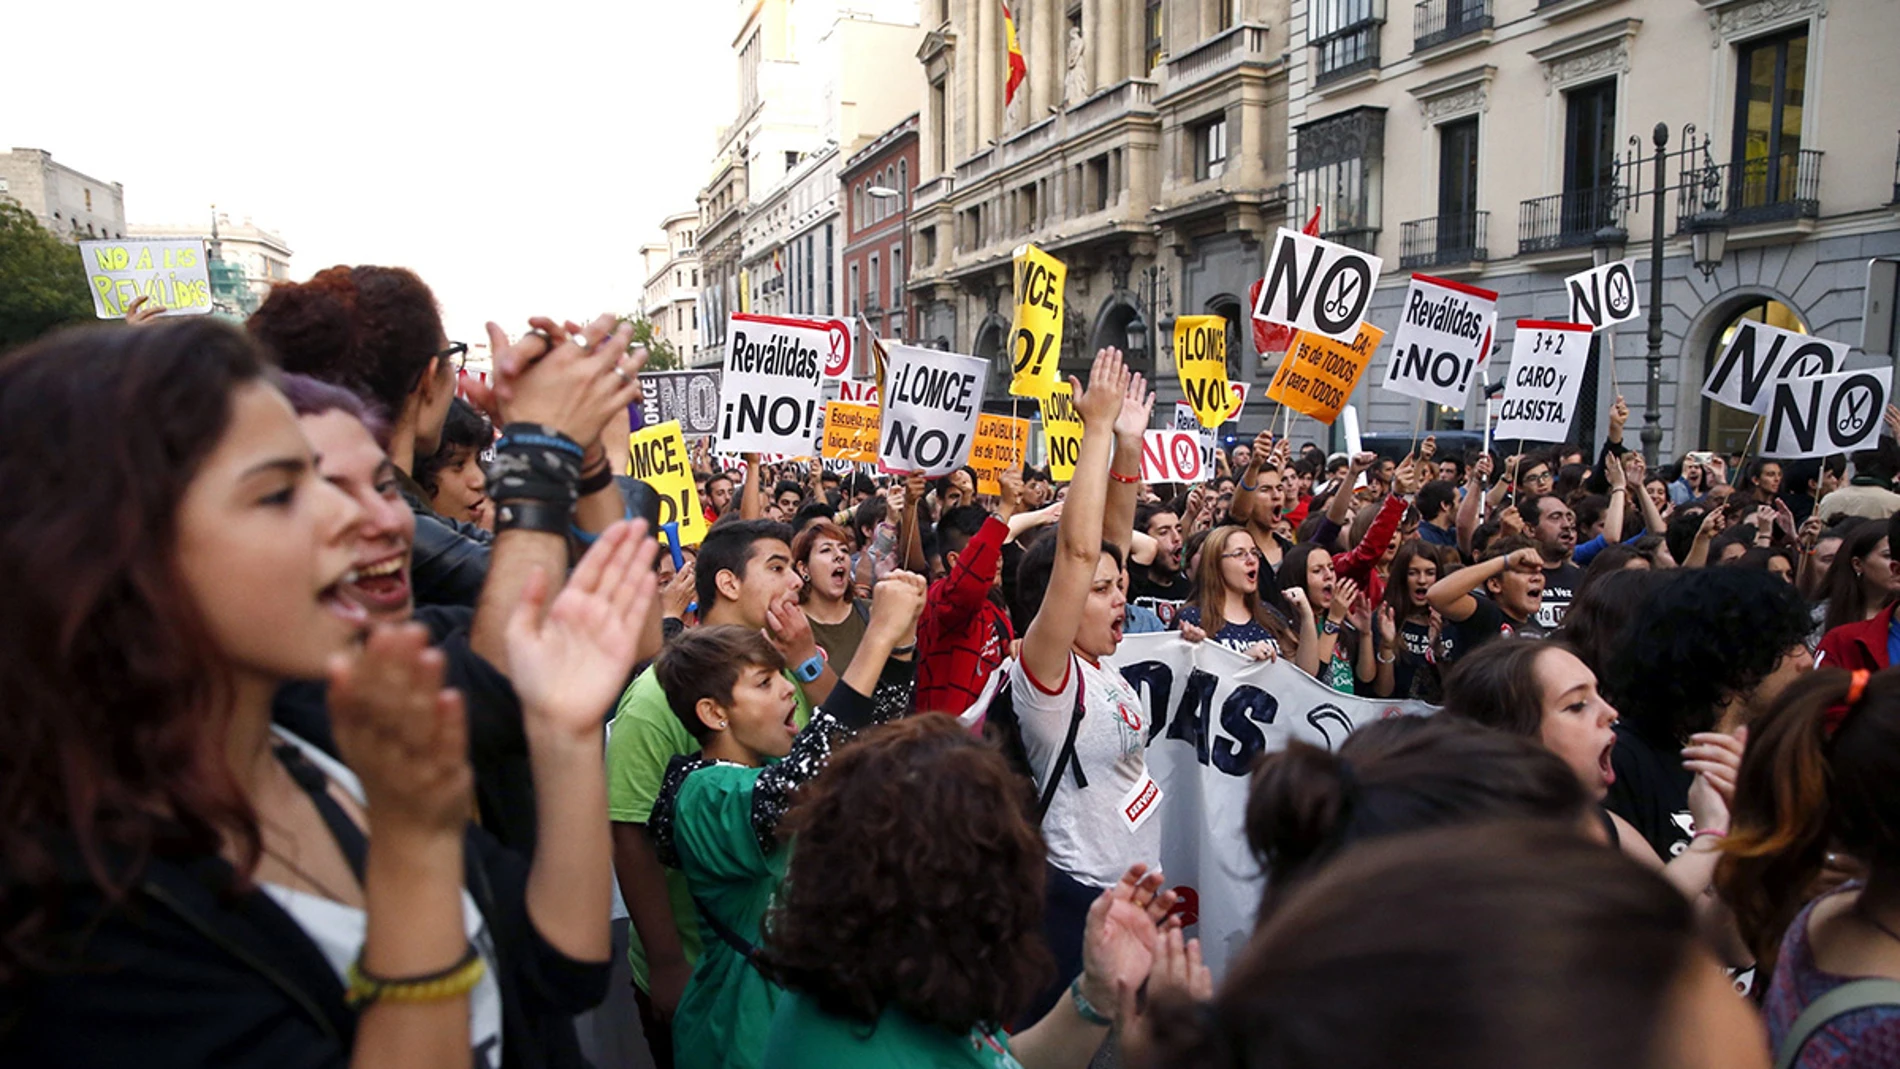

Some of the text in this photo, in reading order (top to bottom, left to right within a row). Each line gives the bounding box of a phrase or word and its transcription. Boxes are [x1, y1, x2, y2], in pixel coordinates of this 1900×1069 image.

[94, 246, 198, 271] NO A LAS
[1260, 235, 1372, 334] NO
[1570, 262, 1635, 327] NO
[1405, 288, 1483, 348] Reválidas,
[730, 330, 821, 387] Reválidas,
[1307, 345, 1323, 366] de
[1389, 342, 1475, 393] ¡NO!
[1708, 323, 1834, 406] NO
[888, 362, 976, 421] ¡LOMCE,
[1185, 377, 1230, 412] NO!
[1286, 371, 1310, 393] para
[1516, 364, 1567, 396] CARO y
[722, 392, 816, 440] ¡NO!
[1500, 398, 1567, 424] CLASISTA.
[1764, 373, 1885, 453] NO
[883, 419, 967, 468] NO!
[984, 443, 994, 459] de
[1050, 435, 1083, 467] NO
[1141, 433, 1200, 480] NO
